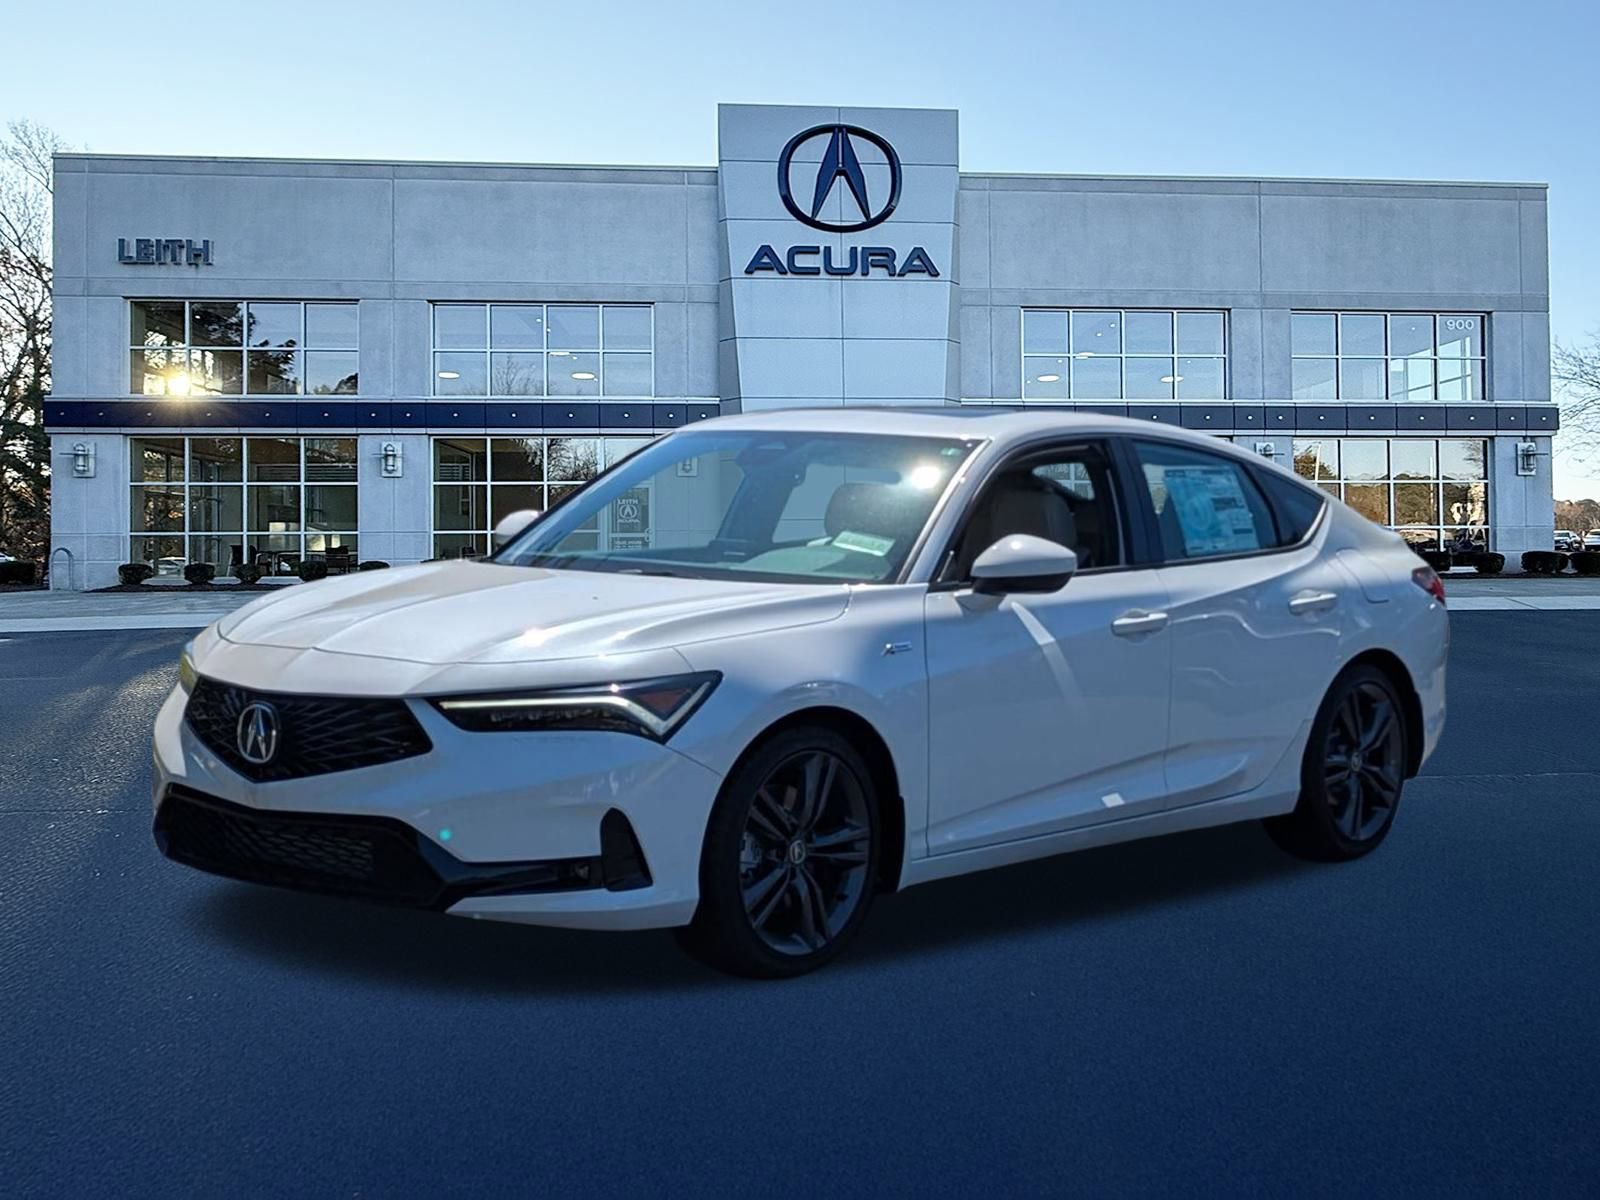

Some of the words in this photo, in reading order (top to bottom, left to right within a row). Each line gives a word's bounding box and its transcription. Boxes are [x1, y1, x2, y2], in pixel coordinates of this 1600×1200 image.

[118, 238, 211, 264] LEITH
[744, 244, 940, 277] ACURA
[1446, 319, 1474, 330] 900
